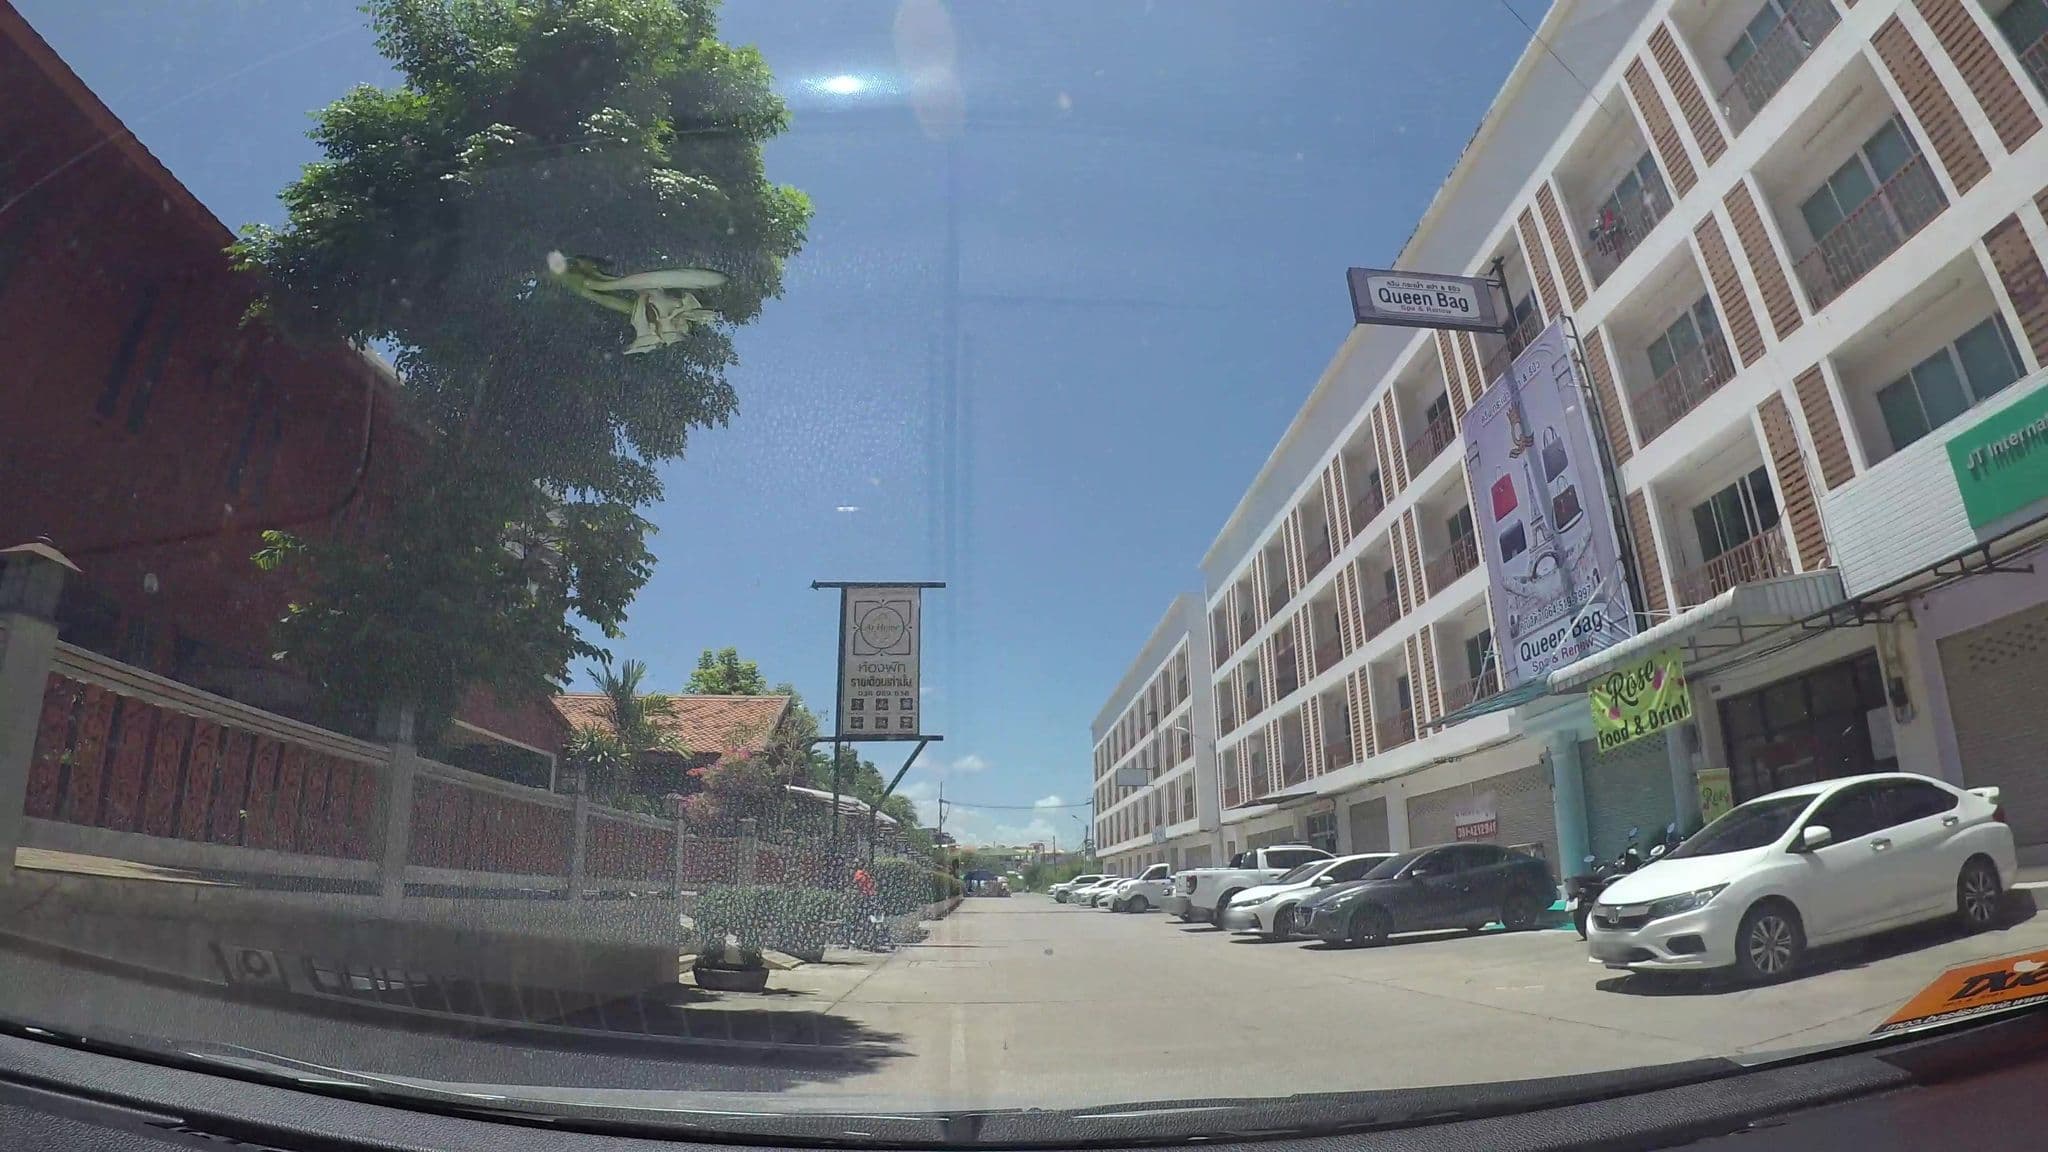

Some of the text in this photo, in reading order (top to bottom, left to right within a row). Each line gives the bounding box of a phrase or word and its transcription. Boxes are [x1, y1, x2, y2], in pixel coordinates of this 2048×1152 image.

[1378, 287, 1469, 313] Queen Bag
[1400, 305, 1415, 313] Spa
[1967, 410, 2048, 469] JT Interna
[1520, 628, 1567, 662] Queen
[1570, 610, 1603, 638] Bag
[1551, 655, 1558, 663] &
[1561, 636, 1594, 660] Renew
[1606, 659, 1654, 708] Rose
[1599, 694, 1690, 750] Food & Drink
